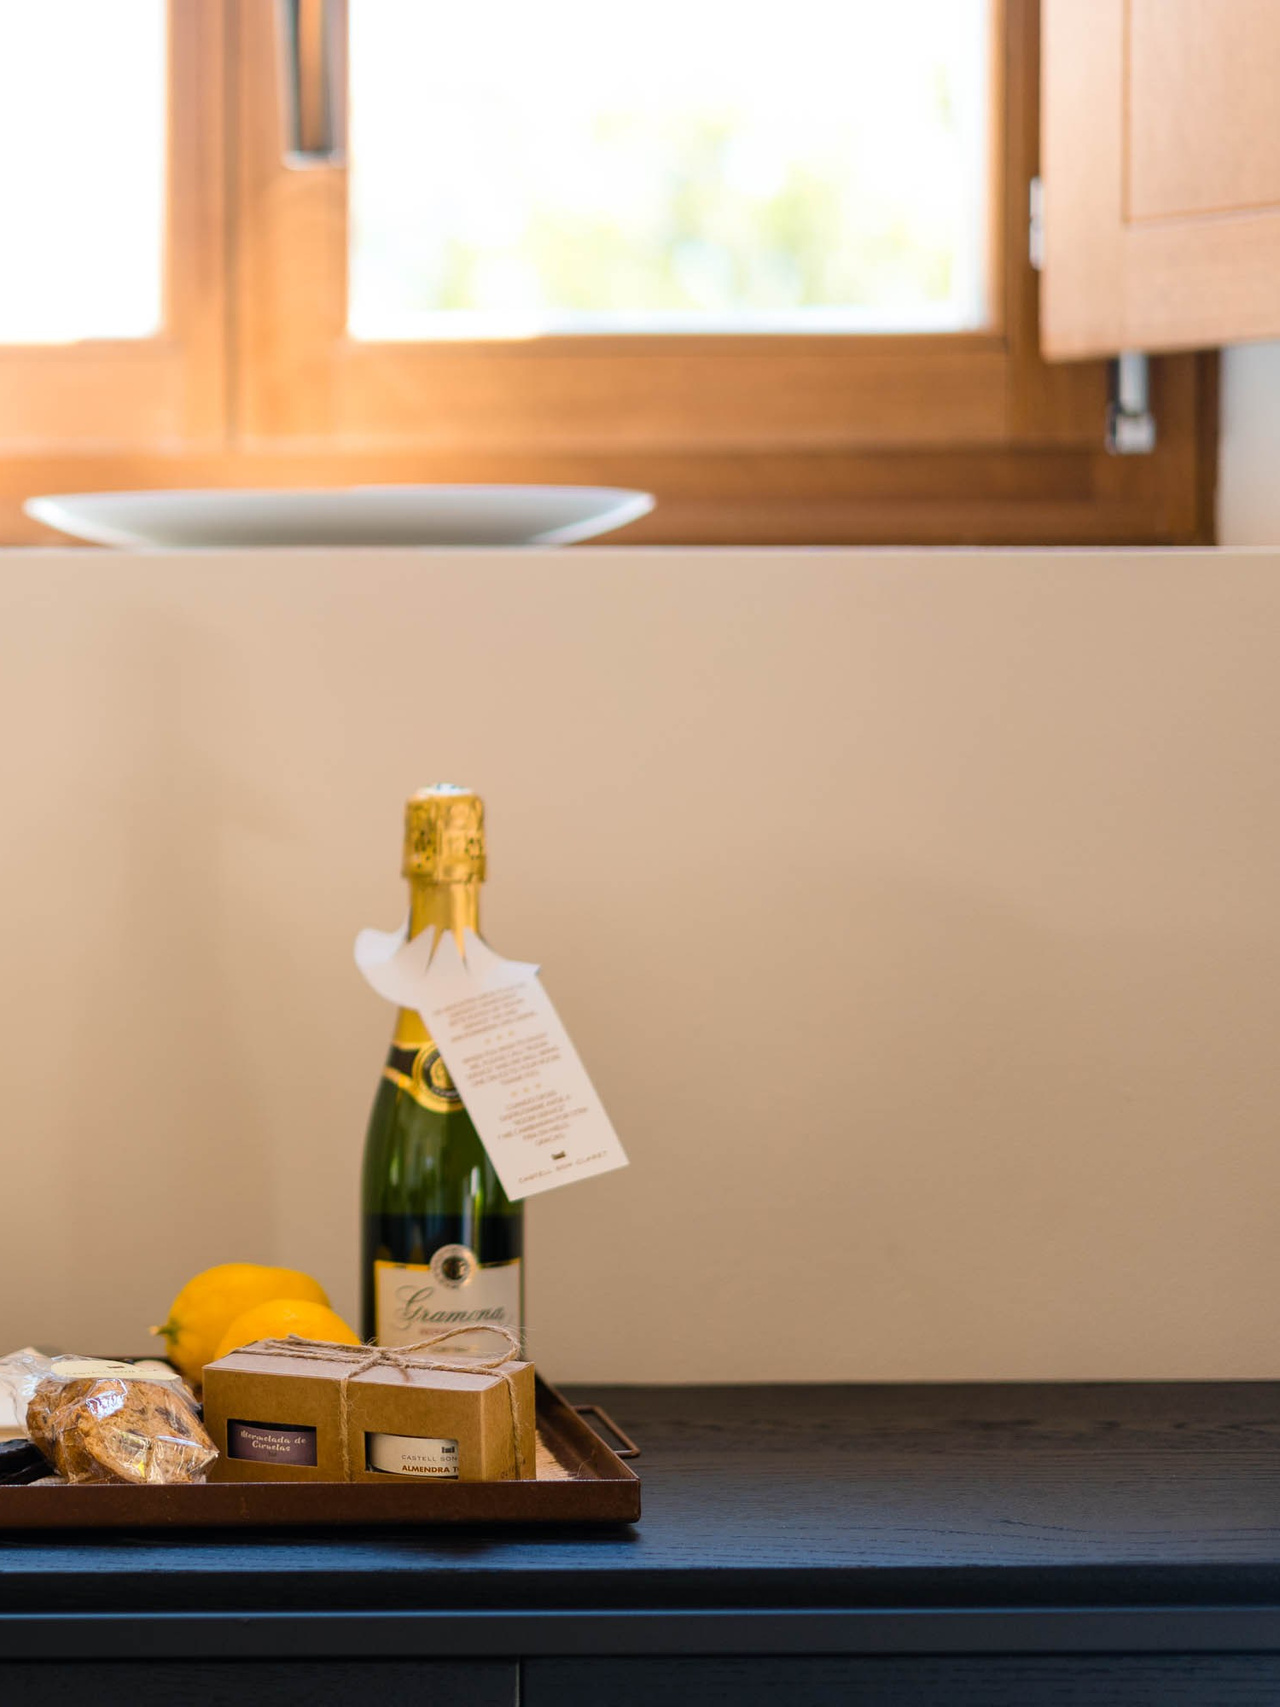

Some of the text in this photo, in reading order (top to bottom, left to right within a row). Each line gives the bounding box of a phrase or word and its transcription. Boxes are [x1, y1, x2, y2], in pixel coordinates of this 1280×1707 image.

[394, 1285, 505, 1331] Gramona
[294, 1436, 306, 1445] de
[252, 1440, 291, 1452] Ciruelas
[401, 1454, 436, 1462] CASTELL
[402, 1465, 450, 1473] ALMENDRA
